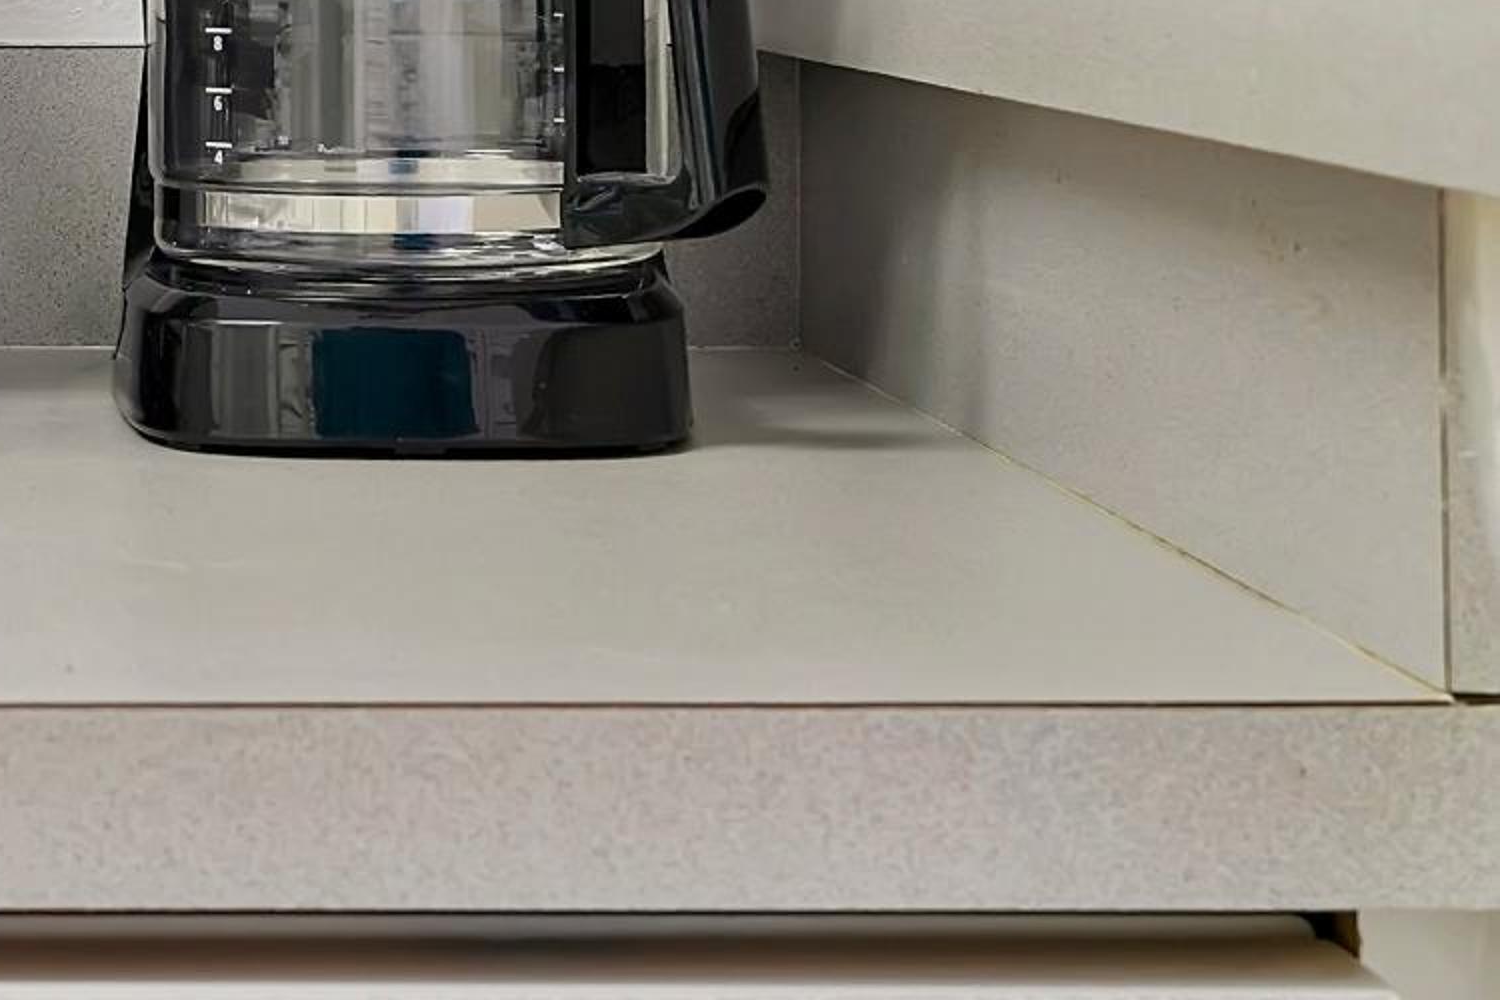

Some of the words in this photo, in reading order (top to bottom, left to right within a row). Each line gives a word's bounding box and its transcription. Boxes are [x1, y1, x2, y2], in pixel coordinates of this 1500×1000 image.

[213, 35, 223, 51] 8
[213, 95, 223, 111] 6
[213, 149, 224, 165] 4
